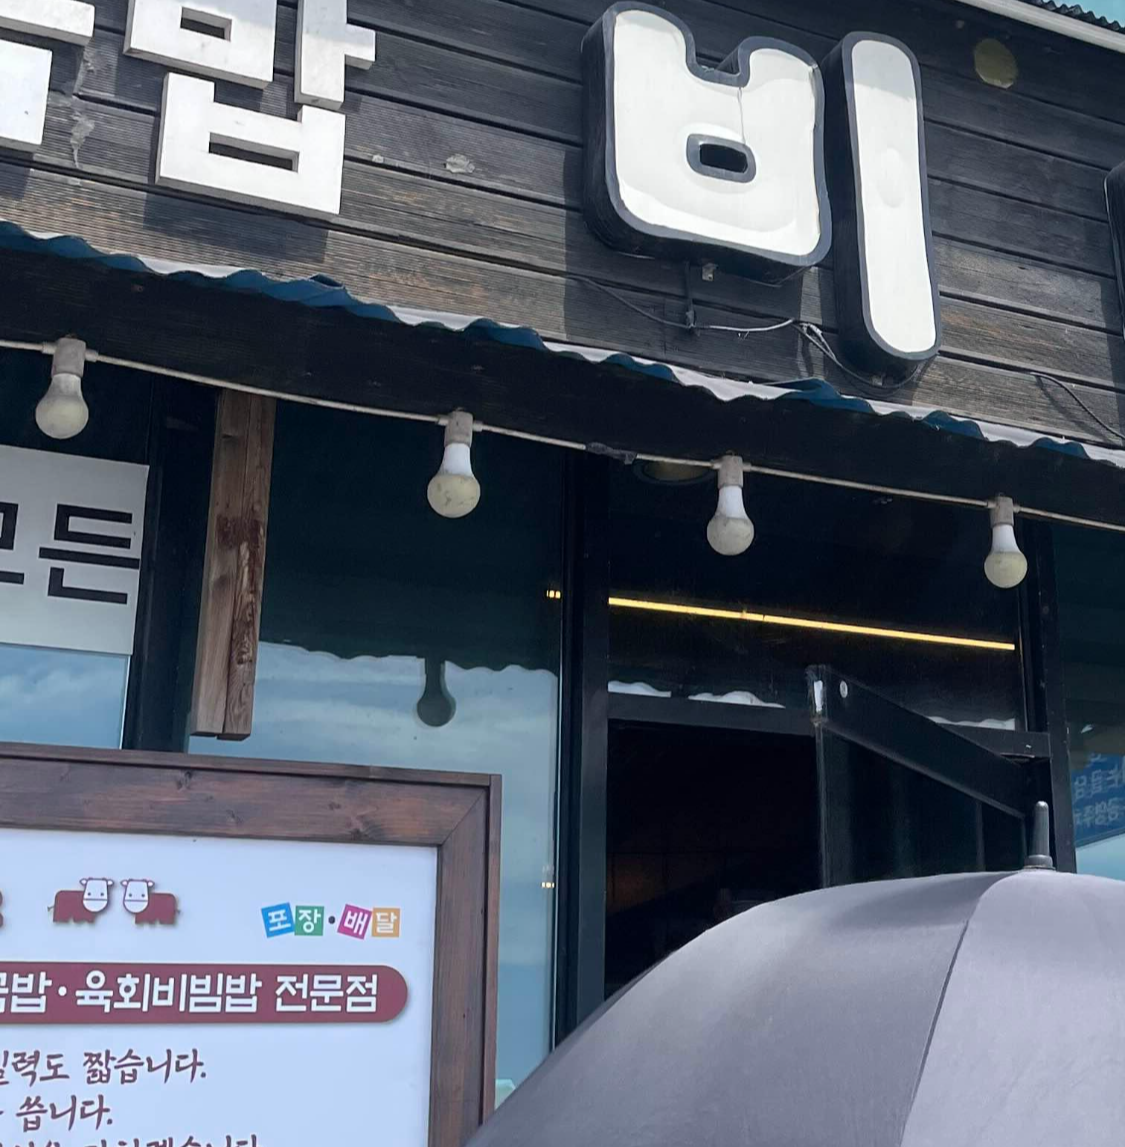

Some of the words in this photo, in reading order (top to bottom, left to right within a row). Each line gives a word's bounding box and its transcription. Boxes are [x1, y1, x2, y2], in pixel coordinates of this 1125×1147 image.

[0, 501, 140, 605] 든
[275, 973, 378, 1013] 전문점
[83, 1048, 207, 1085] 짧습니다.
[16, 1094, 113, 1133] 씁니다.
